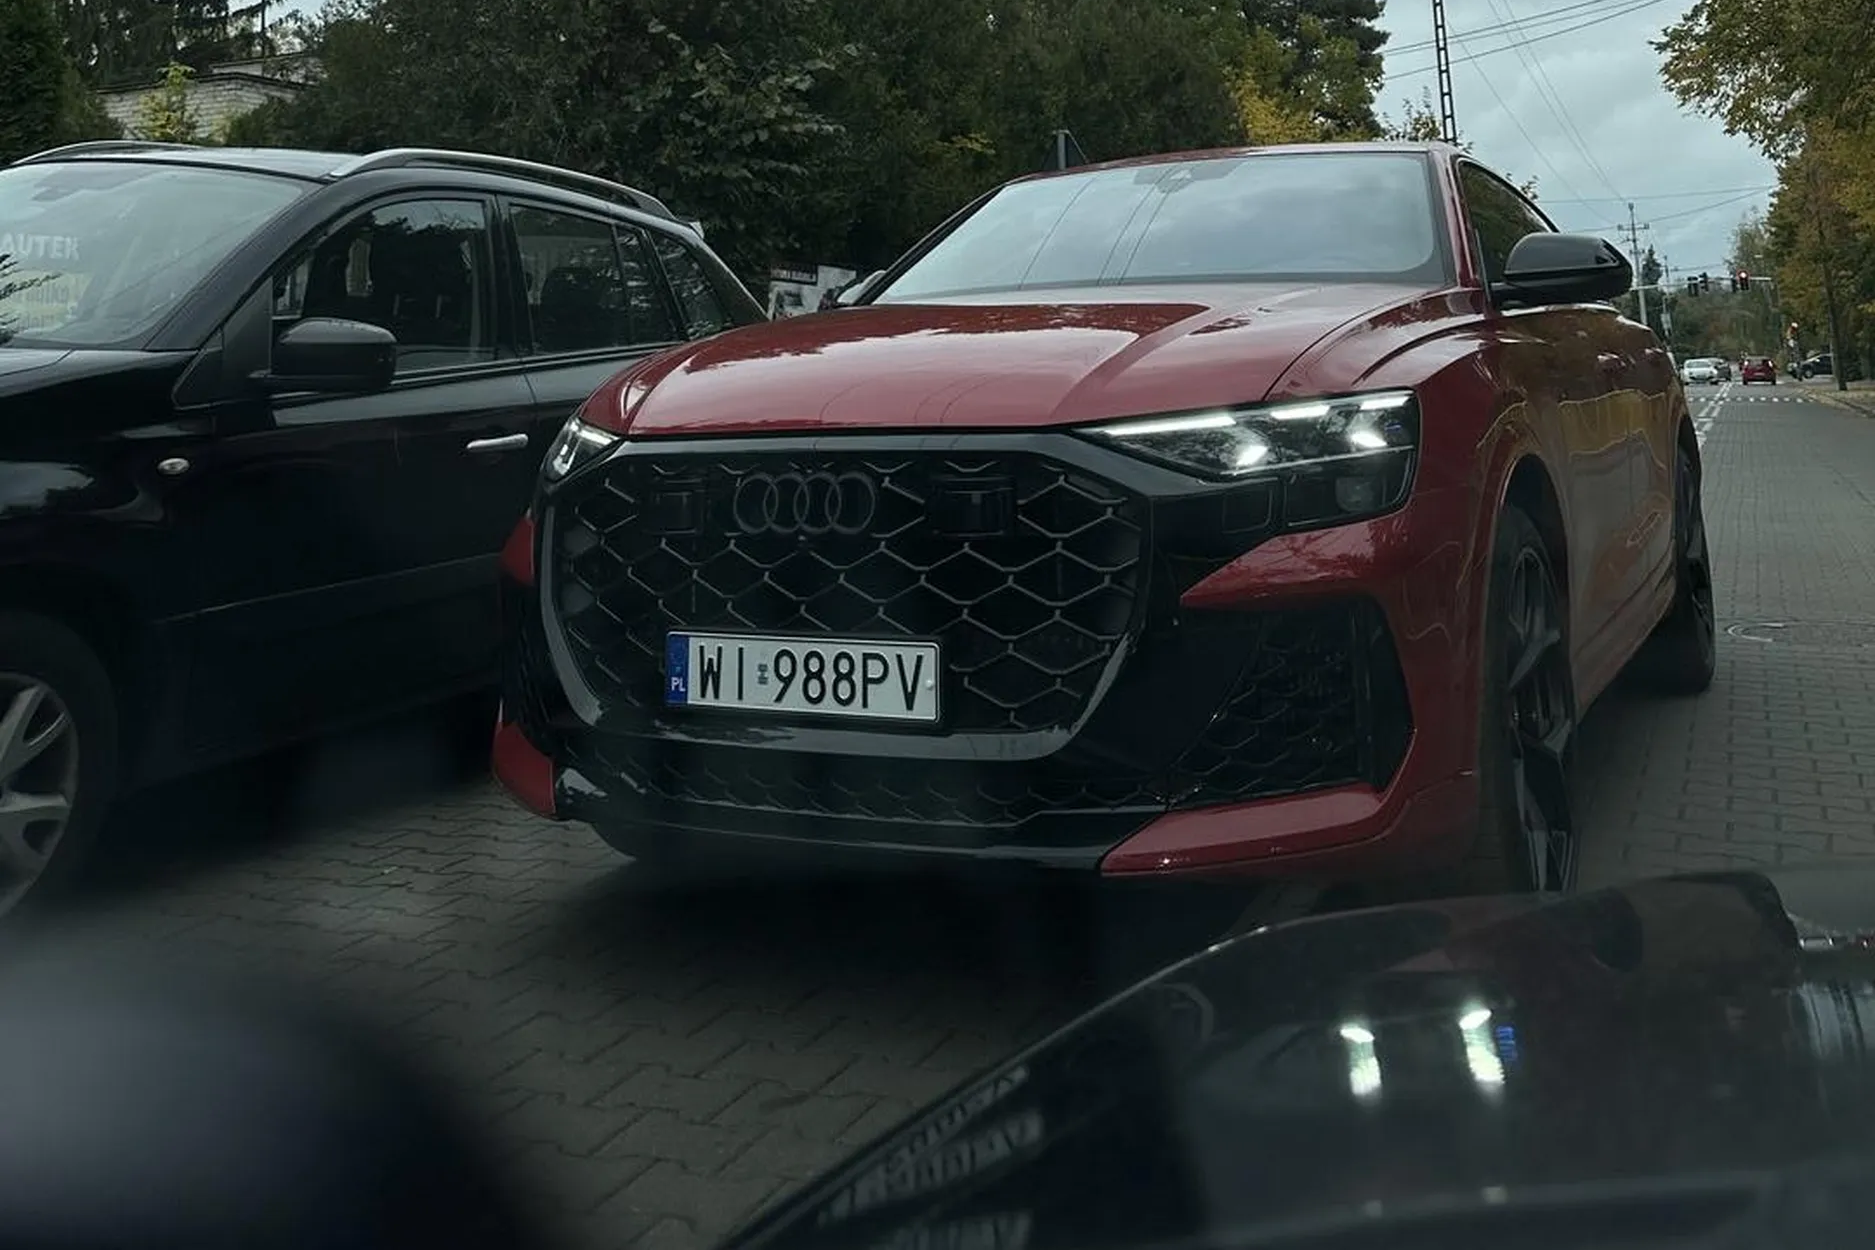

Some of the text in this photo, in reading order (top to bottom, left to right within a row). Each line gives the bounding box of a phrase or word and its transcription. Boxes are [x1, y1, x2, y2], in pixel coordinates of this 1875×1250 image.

[671, 676, 686, 692] PL
[699, 645, 924, 712] WI 988PV
